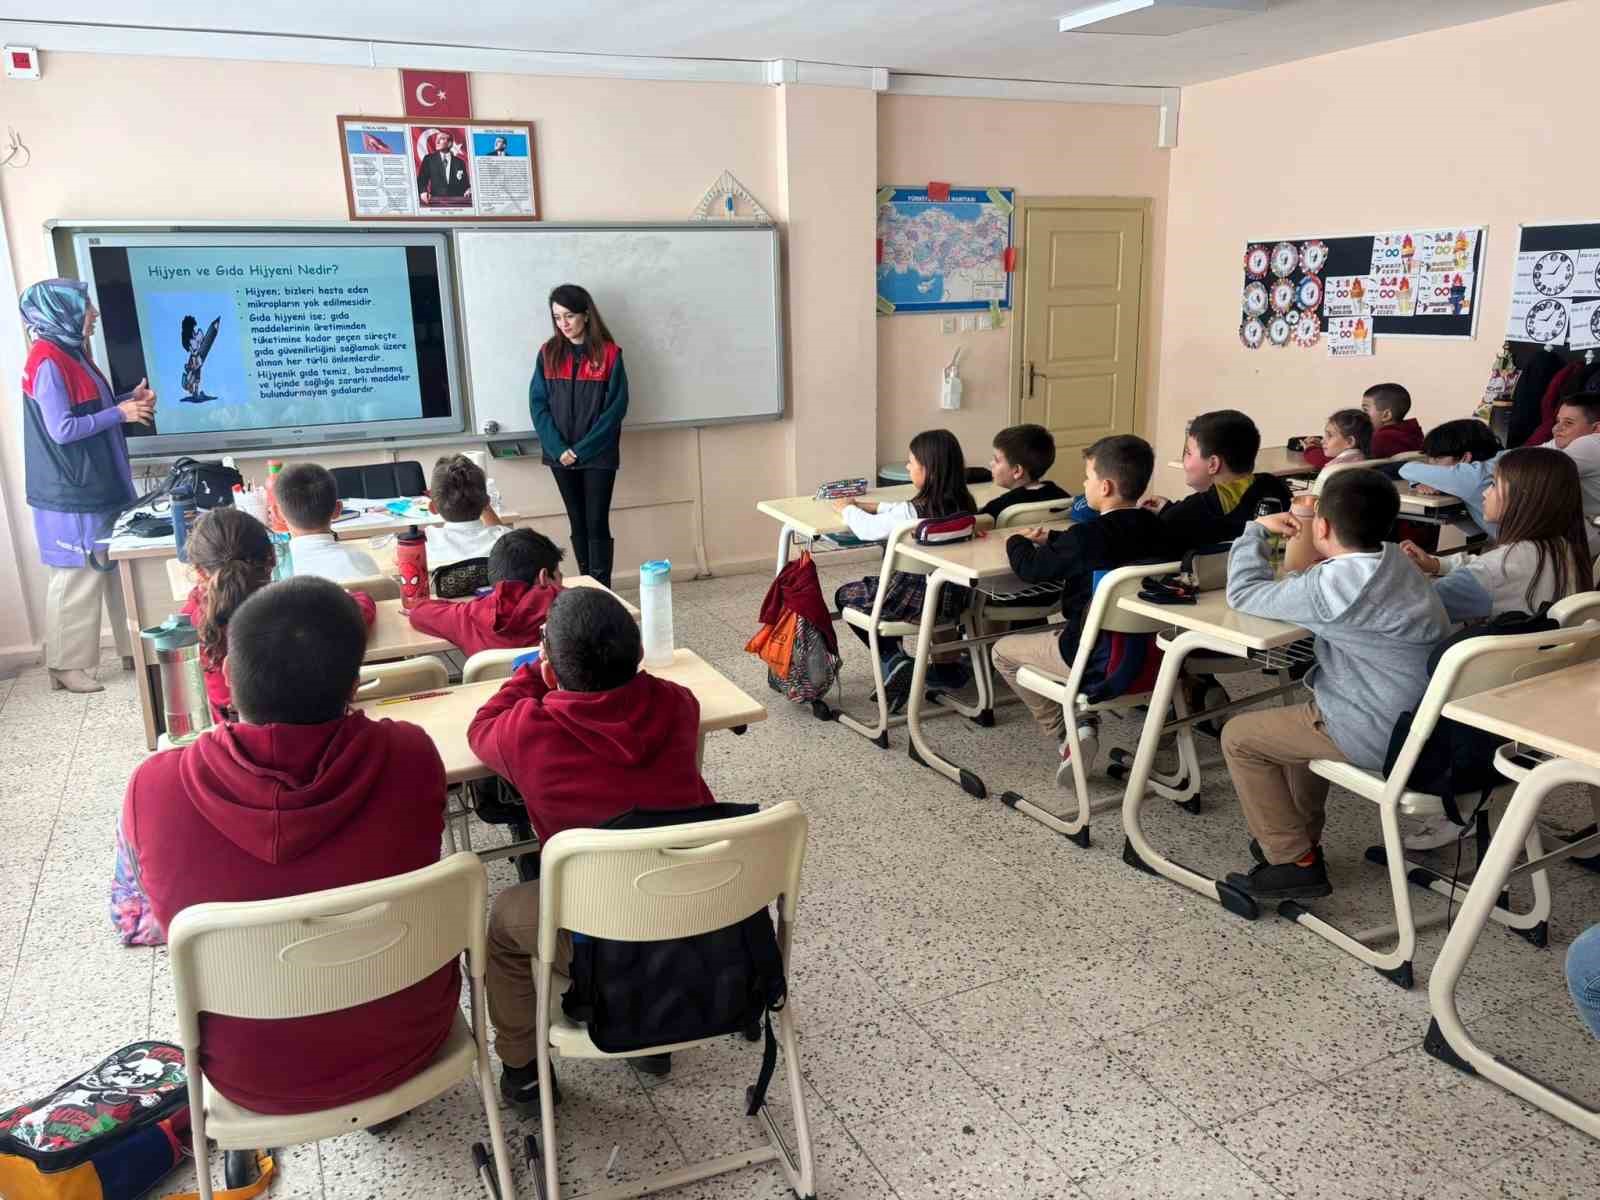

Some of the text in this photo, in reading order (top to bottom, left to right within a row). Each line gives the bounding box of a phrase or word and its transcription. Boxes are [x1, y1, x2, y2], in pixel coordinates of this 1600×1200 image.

[148, 264, 339, 280] Hijyen ve Gıda Hijyeni Nedir?
[285, 286, 314, 296] bizleri
[318, 286, 344, 295] hasta
[248, 300, 300, 310] mikropların
[304, 299, 320, 310] yok
[249, 313, 270, 322] Gıda
[274, 312, 306, 324] hijyeni
[330, 312, 350, 322] gıda
[251, 322, 366, 333] maddelerinin üretiminden
[253, 336, 301, 344] tüketimine
[306, 334, 330, 342] kadar
[336, 335, 361, 344] geçen
[254, 348, 274, 357] gıda
[340, 342, 380, 353] sağlamak
[384, 342, 408, 350] üzere
[307, 356, 328, 365] türlü
[258, 368, 296, 380] Hijyenik
[300, 368, 318, 378] gıda
[274, 379, 300, 390] içinde
[338, 376, 368, 385] zararlı
[370, 374, 410, 383] maddeler
[260, 389, 328, 400] bulundurmayan
